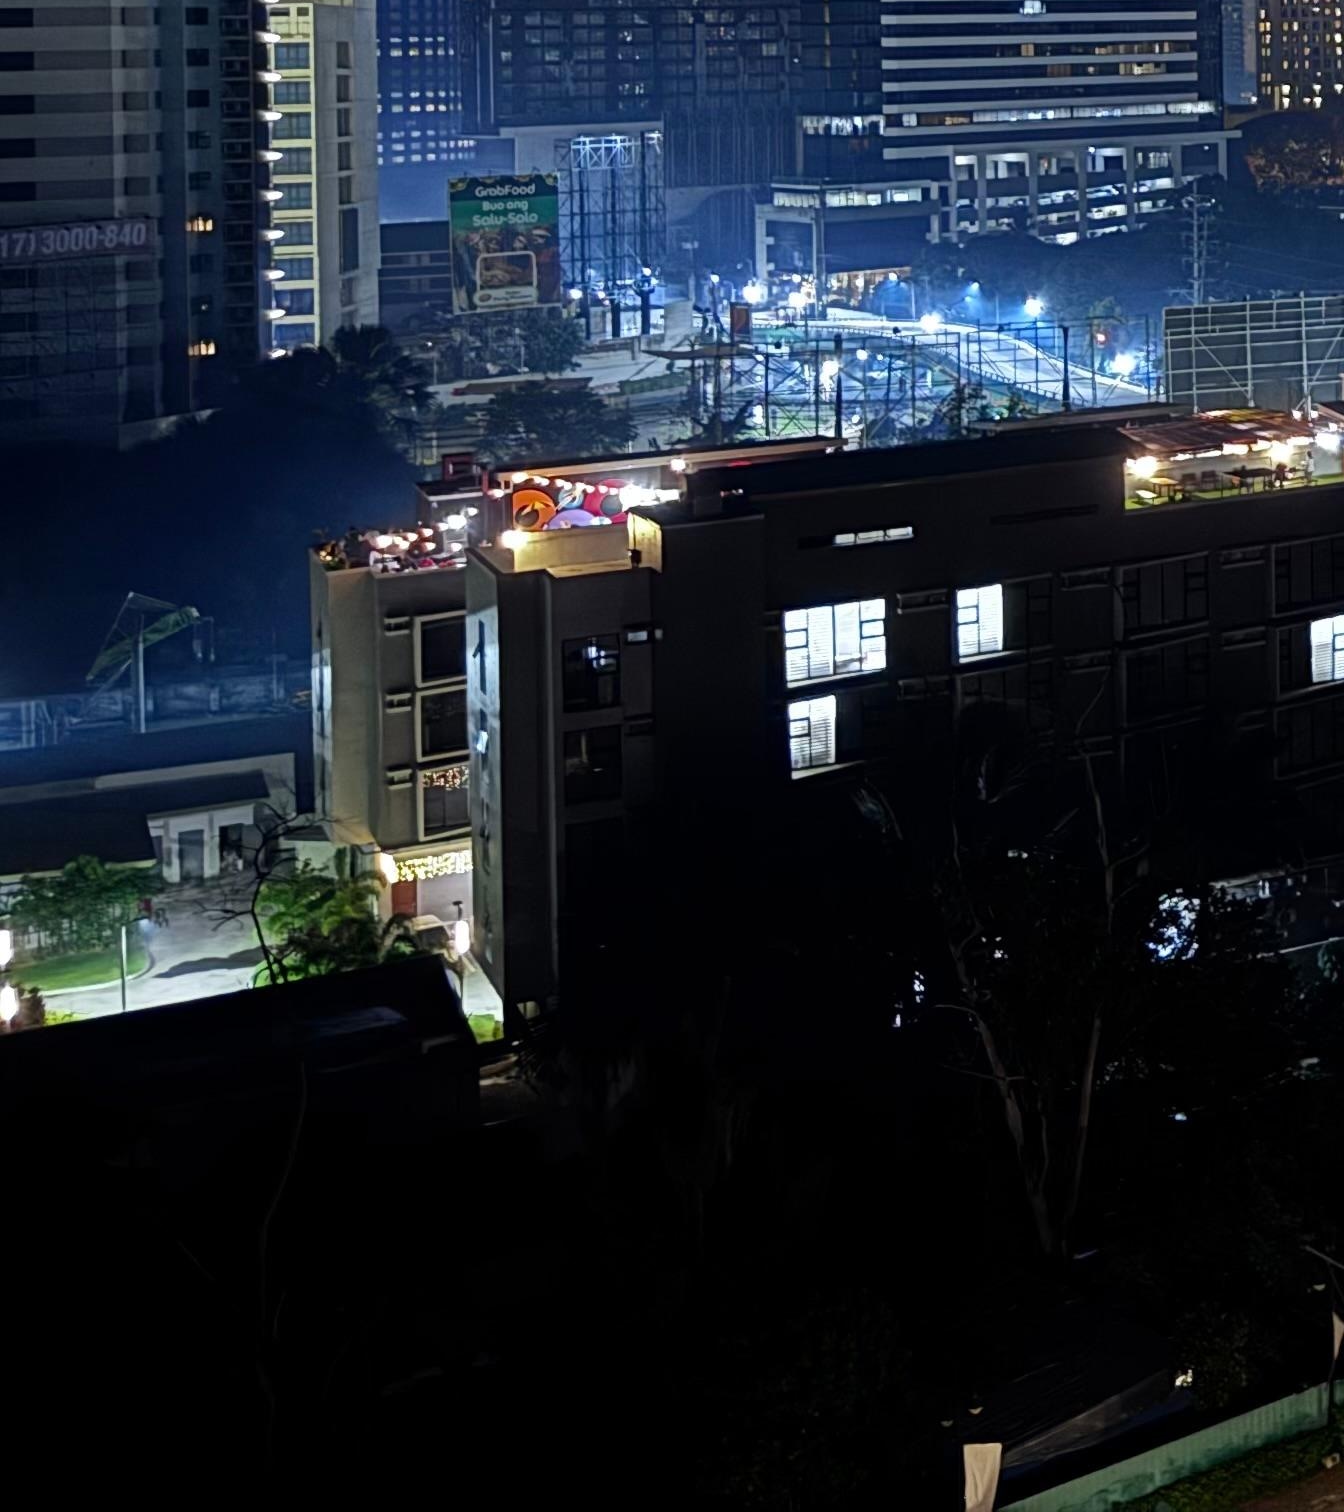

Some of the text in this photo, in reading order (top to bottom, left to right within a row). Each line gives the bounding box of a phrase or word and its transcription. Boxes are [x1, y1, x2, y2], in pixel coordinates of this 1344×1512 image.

[475, 183, 536, 197] GrabFood
[482, 200, 529, 211] Buo ang
[40, 222, 147, 254] 3000-840
